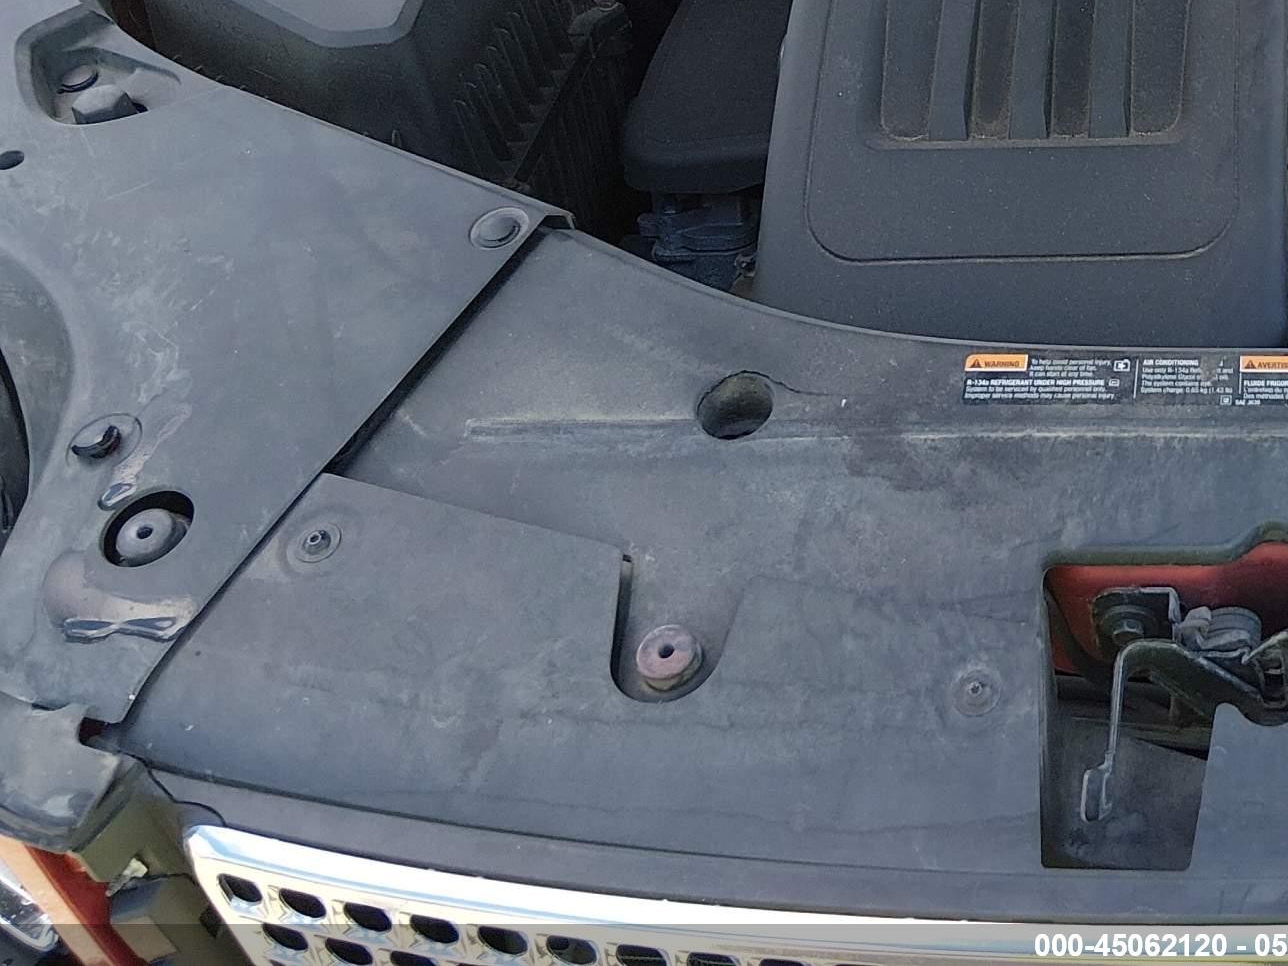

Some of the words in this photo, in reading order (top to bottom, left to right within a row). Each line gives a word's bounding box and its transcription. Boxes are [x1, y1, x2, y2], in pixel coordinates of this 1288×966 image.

[984, 360, 1020, 369] WARNING
[966, 378, 990, 386] R-134a
[990, 378, 1033, 386] REFRIGERANT
[1033, 378, 1055, 386] UNDER
[1056, 378, 1071, 386] HIGH
[1072, 378, 1105, 386] PRESSURE
